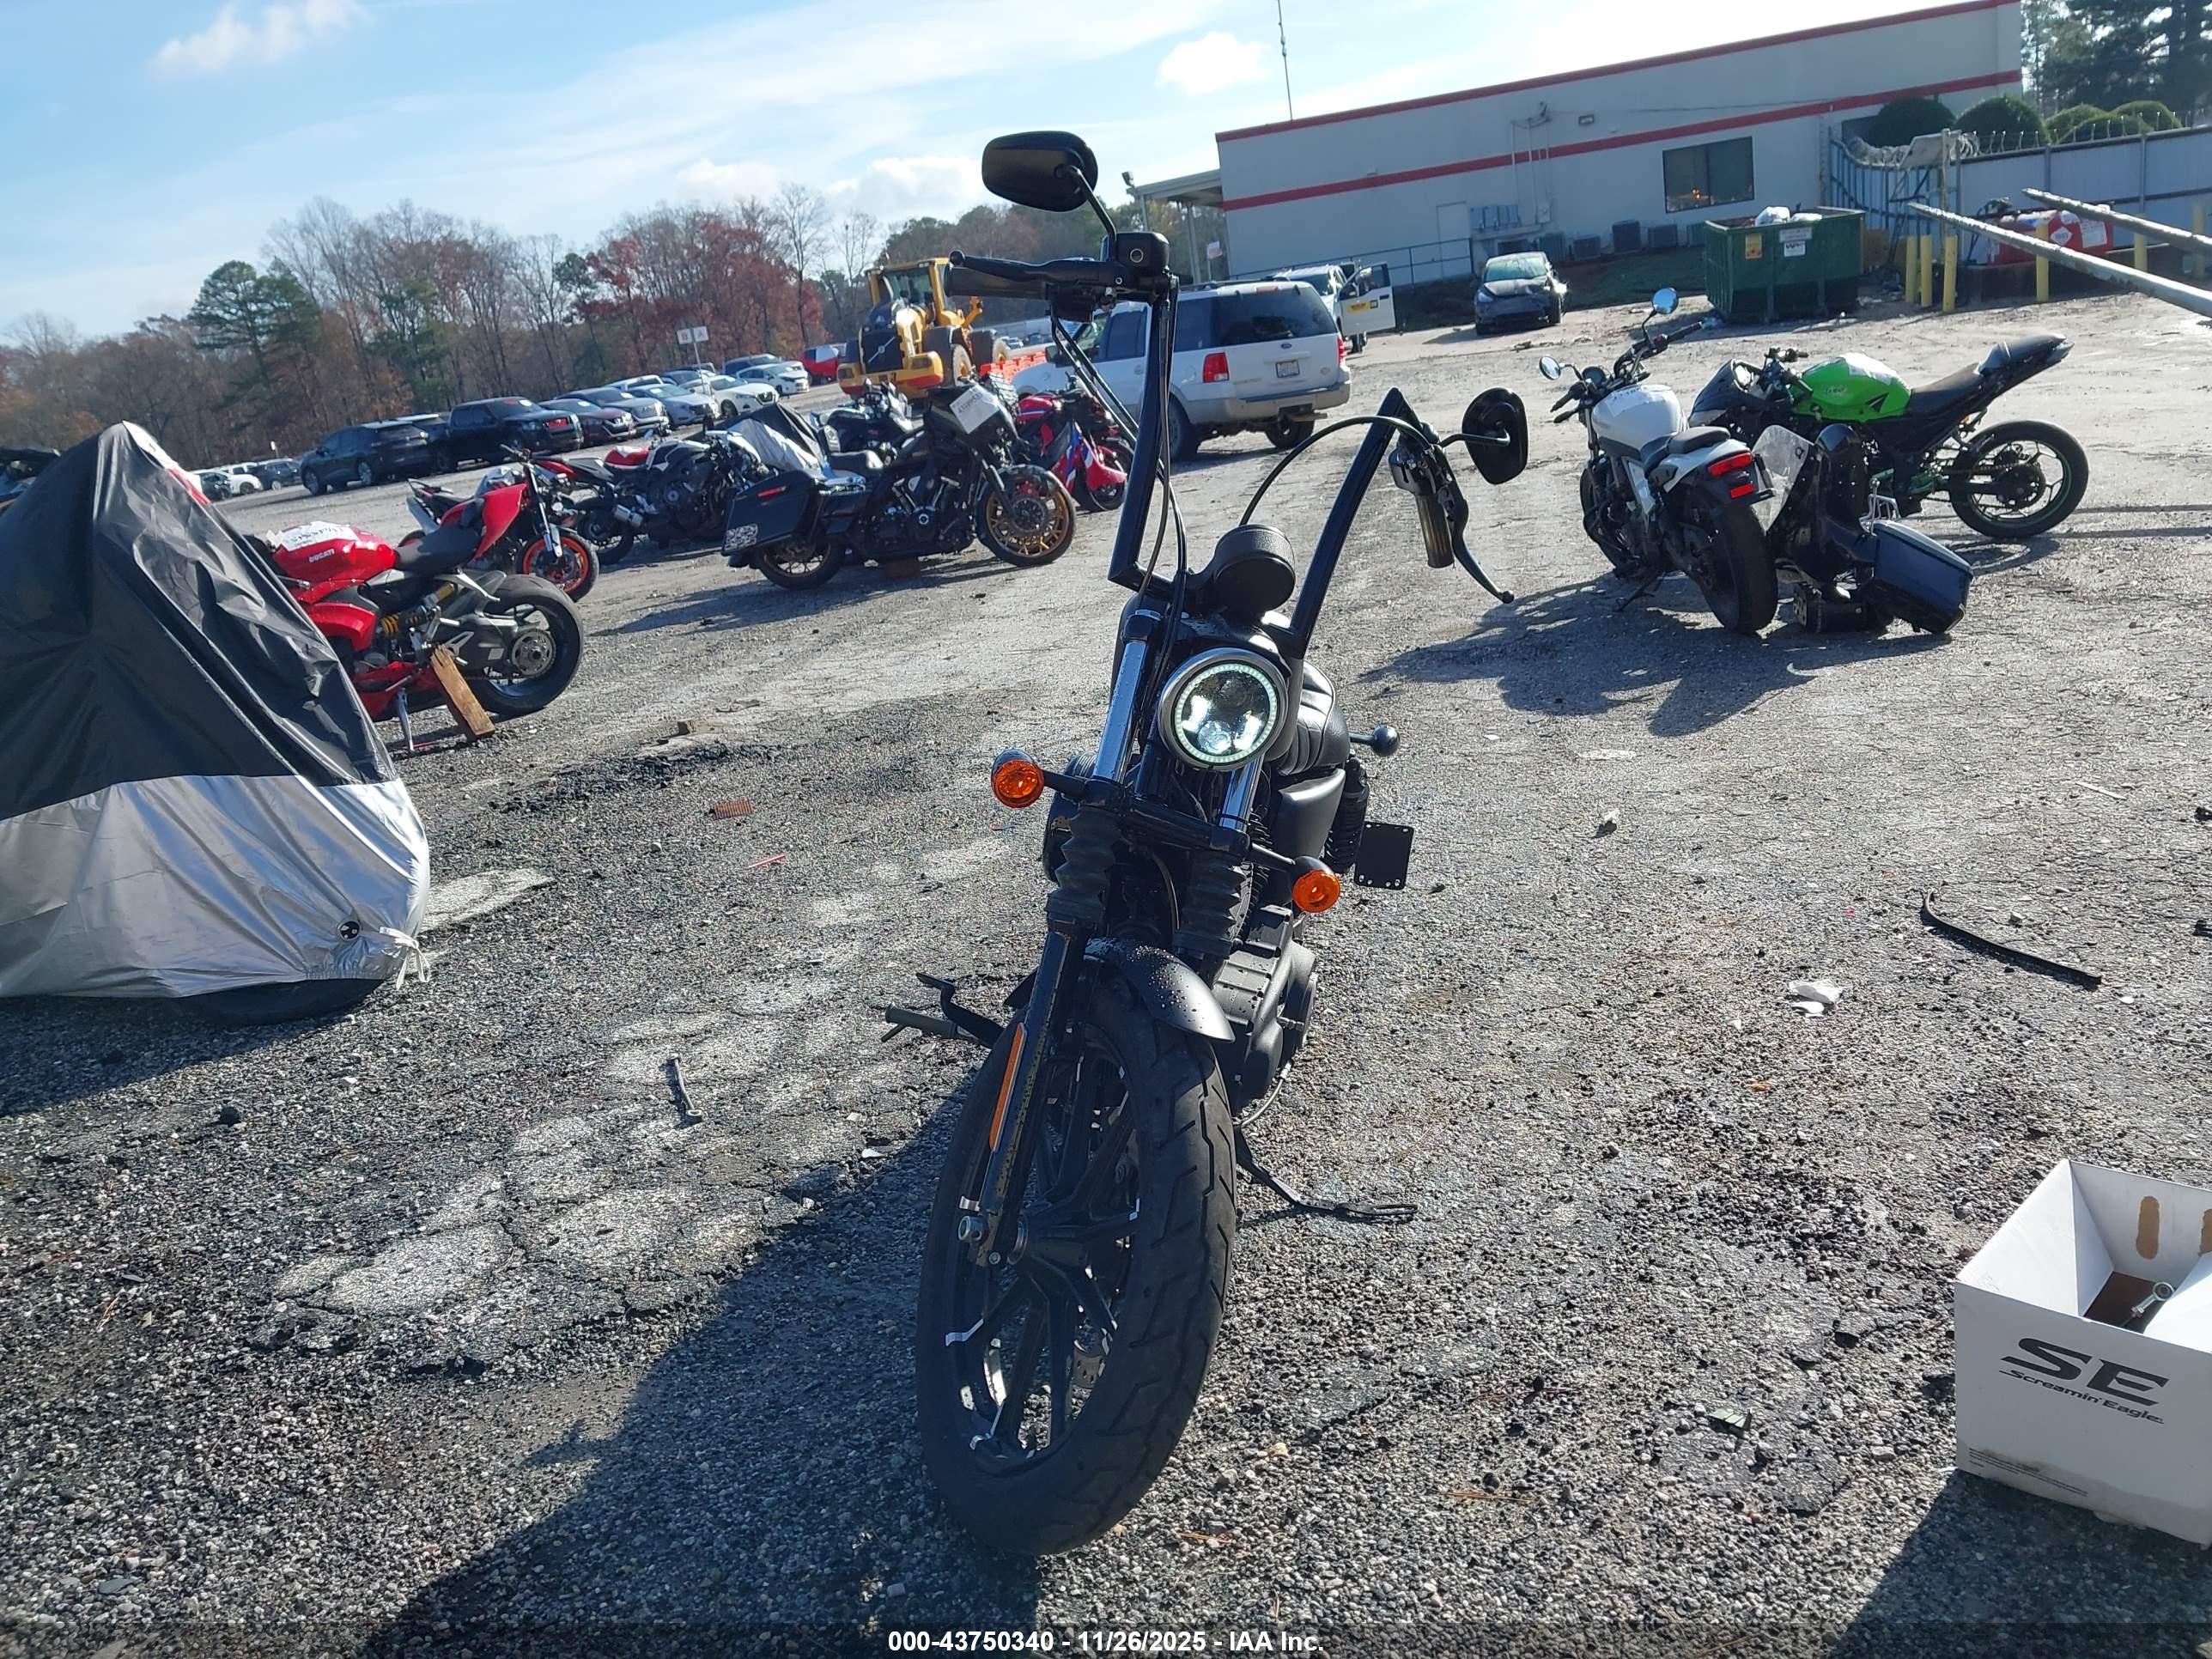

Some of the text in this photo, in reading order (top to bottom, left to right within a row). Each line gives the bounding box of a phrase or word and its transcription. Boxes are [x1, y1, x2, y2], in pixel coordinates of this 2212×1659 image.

[308, 548, 336, 563] DUCATI
[1999, 1369, 2164, 1425] Screamin' Eagle
[2000, 1337, 2170, 1407] SE
